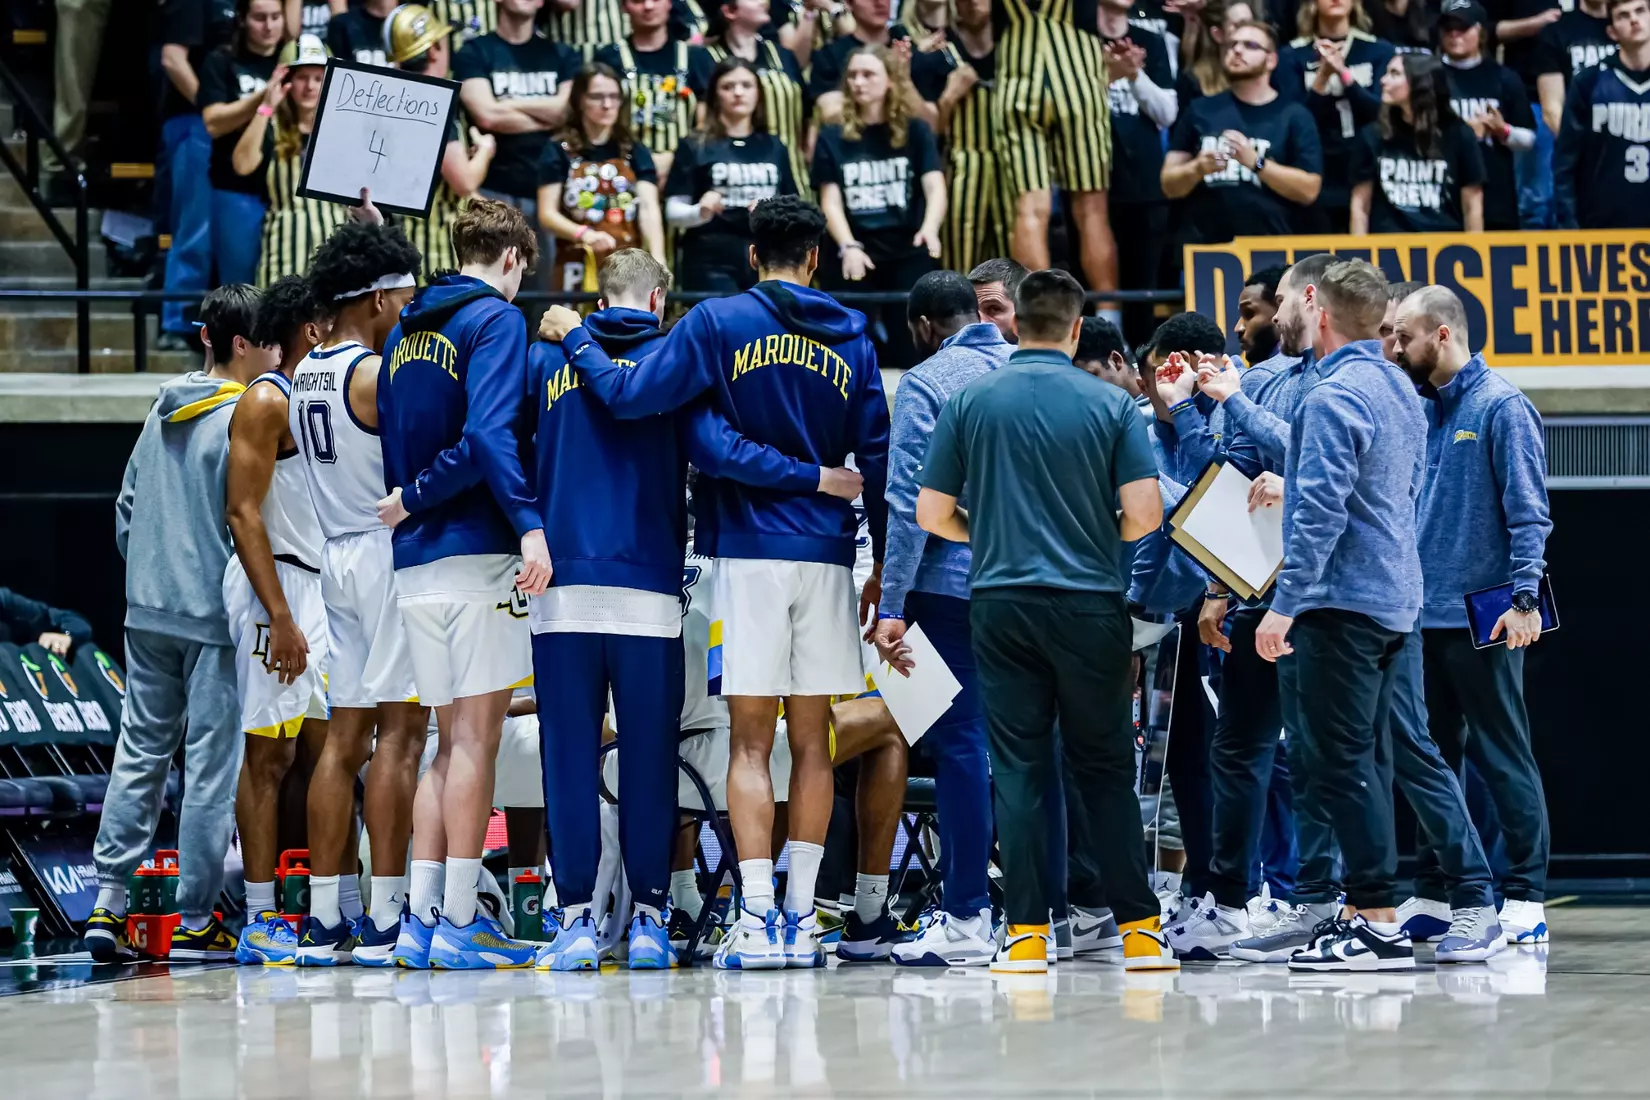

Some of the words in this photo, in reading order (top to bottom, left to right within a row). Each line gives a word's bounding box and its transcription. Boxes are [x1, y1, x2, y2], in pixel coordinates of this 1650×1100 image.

[335, 73, 438, 116] Deflections
[493, 71, 558, 95] PAINT
[368, 130, 386, 173] 4
[1624, 145, 1649, 183] 3
[711, 162, 778, 186] PAINT
[841, 156, 909, 187] PAINT
[1379, 157, 1447, 184] PAINT
[844, 180, 907, 210] CREW
[1381, 181, 1441, 213] CREW
[293, 371, 337, 393] WRIGHTSIL
[732, 333, 852, 401] MARQUETTE
[297, 399, 338, 466] 10
